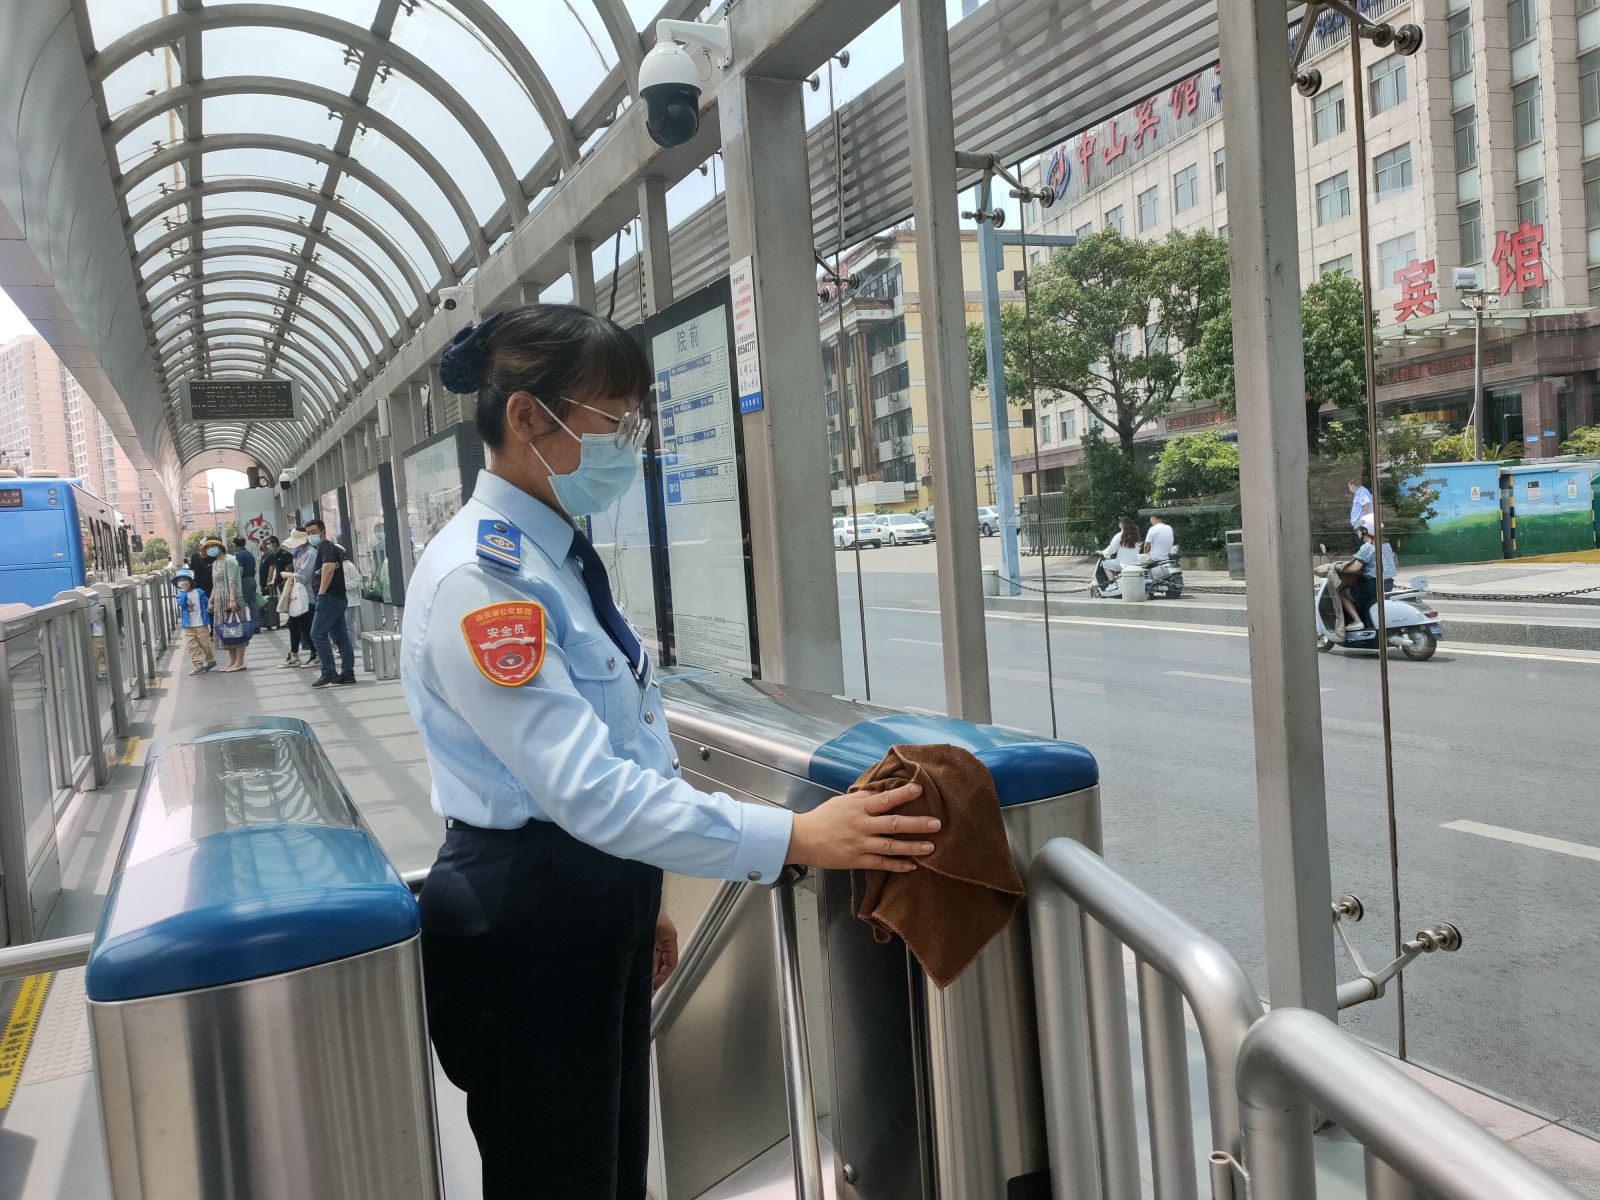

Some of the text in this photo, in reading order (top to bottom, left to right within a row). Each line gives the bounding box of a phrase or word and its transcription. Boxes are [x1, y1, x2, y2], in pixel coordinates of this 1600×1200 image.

[1393, 220, 1545, 322] 宾馆
[676, 323, 699, 353] 院前
[670, 483, 680, 493] B13
[475, 607, 533, 622] 连云港公交集团
[487, 624, 526, 638] 安全员
